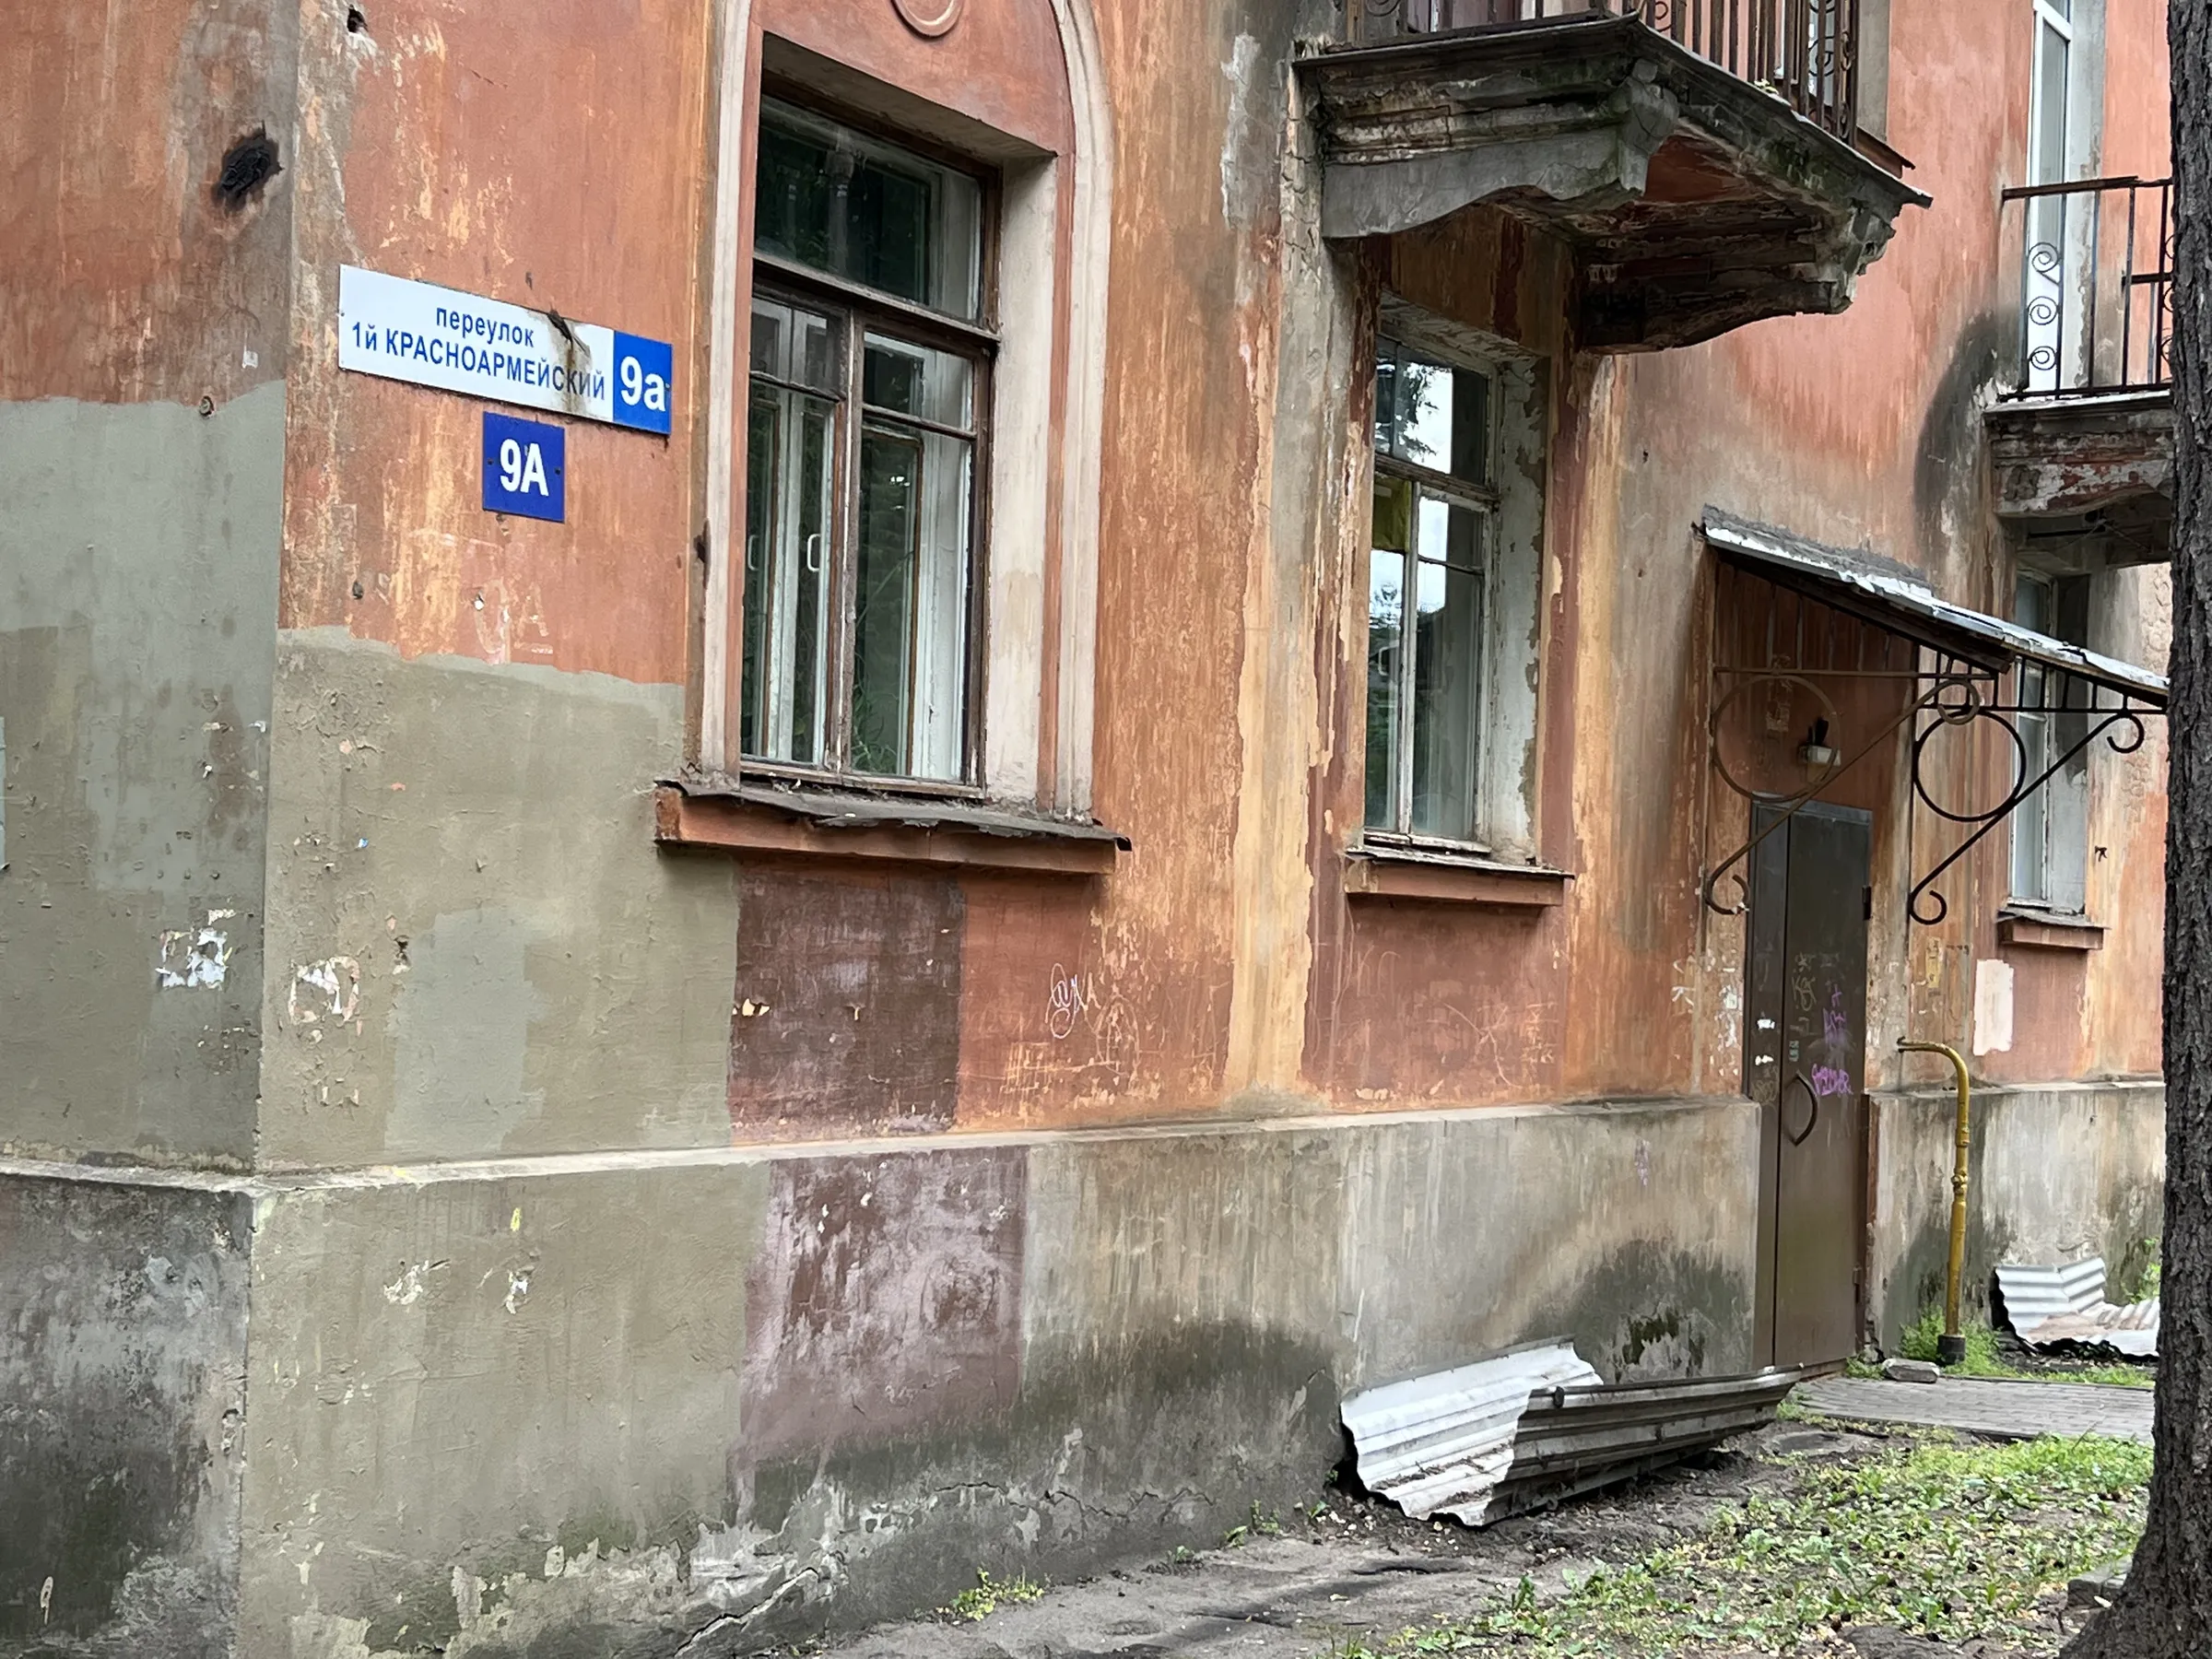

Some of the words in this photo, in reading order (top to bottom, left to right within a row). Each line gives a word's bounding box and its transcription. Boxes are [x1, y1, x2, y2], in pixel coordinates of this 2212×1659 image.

[436, 307, 535, 348] переулок
[352, 322, 378, 352] 1й
[386, 329, 606, 401] КРАСНОАРМЕЙСКИЙ
[619, 356, 666, 412] 9а
[500, 438, 549, 497] 9А
